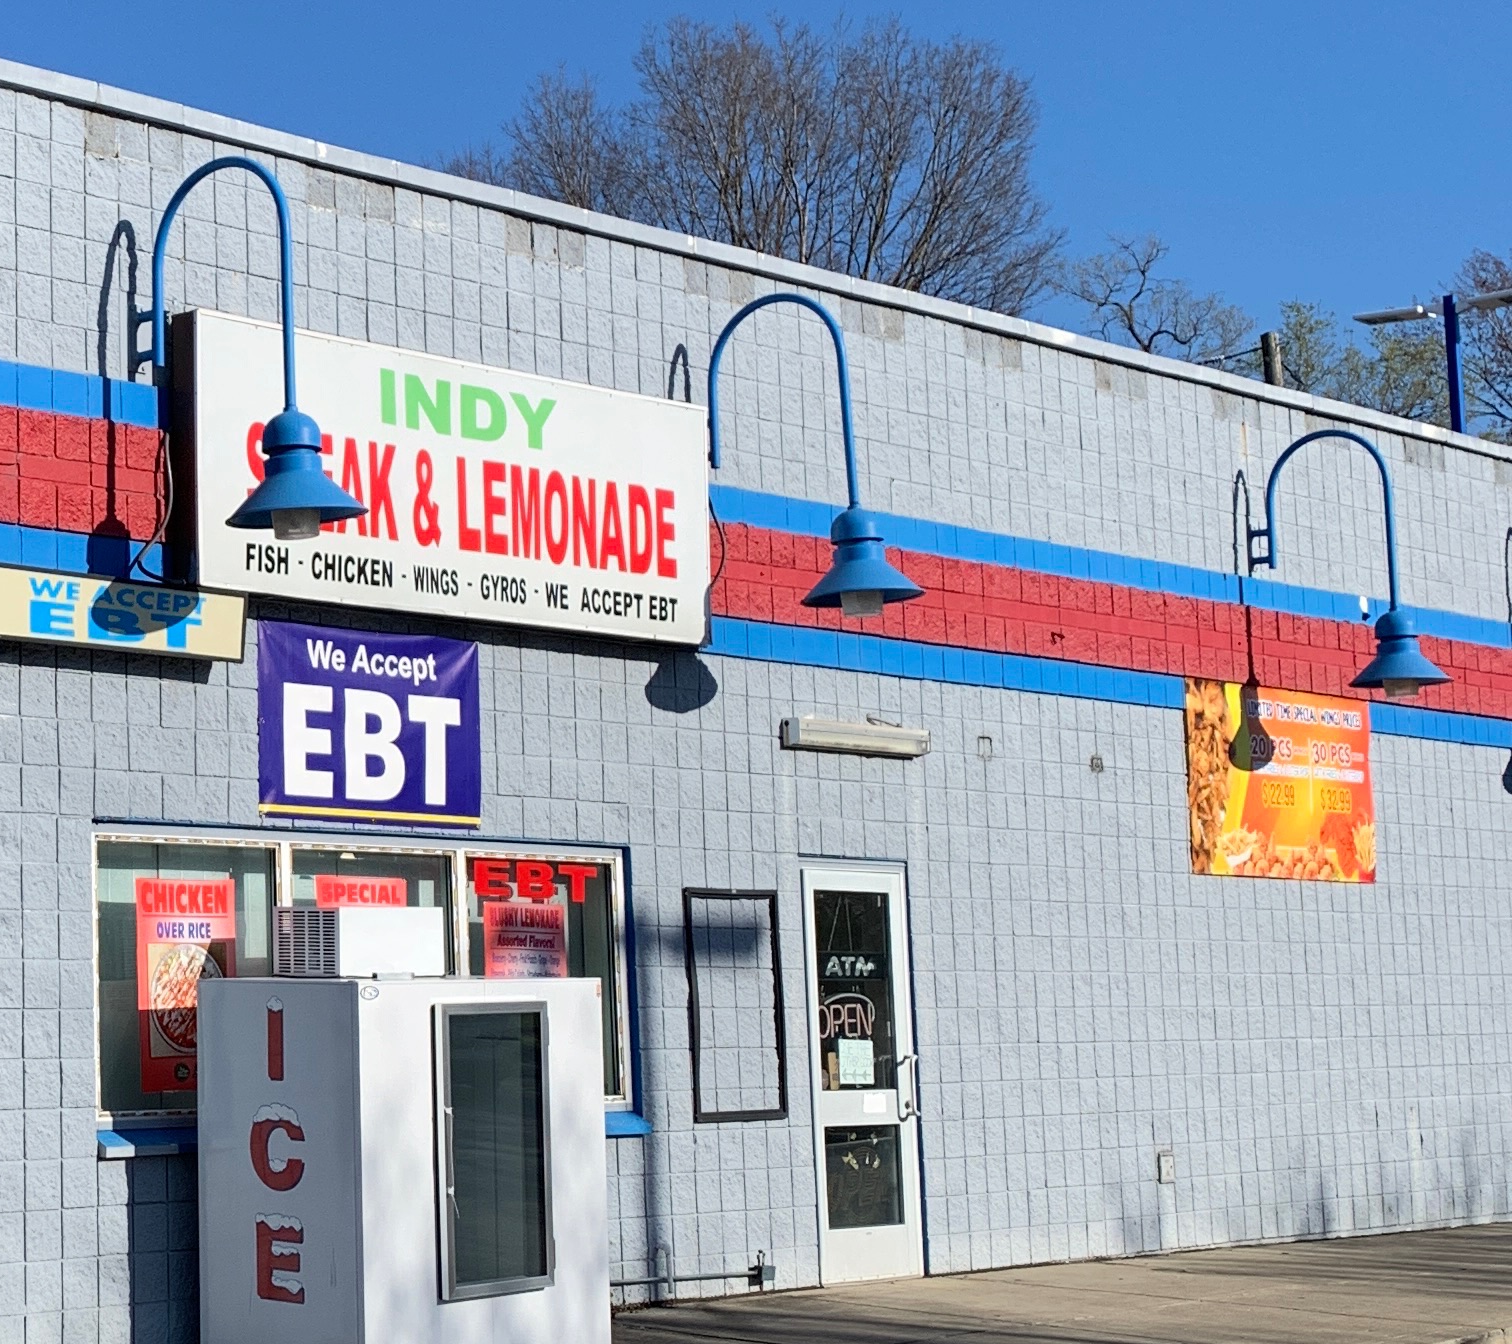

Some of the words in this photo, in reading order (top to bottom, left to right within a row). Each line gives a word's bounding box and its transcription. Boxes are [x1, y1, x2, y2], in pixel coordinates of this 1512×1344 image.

[379, 368, 556, 450] INDY
[246, 421, 399, 541] SAK
[413, 449, 442, 549] &
[456, 456, 678, 579] LEMONADE
[29, 577, 80, 601] WE
[91, 585, 207, 615] ACCEPT
[245, 542, 289, 575] FISH
[311, 551, 393, 588] CHICKEN
[413, 564, 459, 597] WINGS
[480, 573, 527, 605] GYROS
[545, 581, 569, 611] WE
[581, 587, 644, 619] ACCEPT
[649, 595, 678, 623] EBT
[30, 600, 202, 649] EBT
[307, 639, 345, 673] We
[351, 644, 437, 683] Accept
[283, 682, 461, 806] EBT
[1251, 737, 1266, 755] 20
[1270, 738, 1293, 759] PCS
[1312, 742, 1327, 765] 30
[1330, 744, 1352, 765] PCS
[141, 882, 228, 914] CHICKEN
[322, 882, 400, 905] SPECIAL
[474, 860, 597, 904] EBT
[157, 921, 185, 939] OVER
[188, 922, 212, 939] RICE
[497, 934, 528, 948] Assorted
[825, 955, 875, 977] ATM
[819, 1003, 873, 1039] OPEN
[249, 996, 306, 1305] ICE
